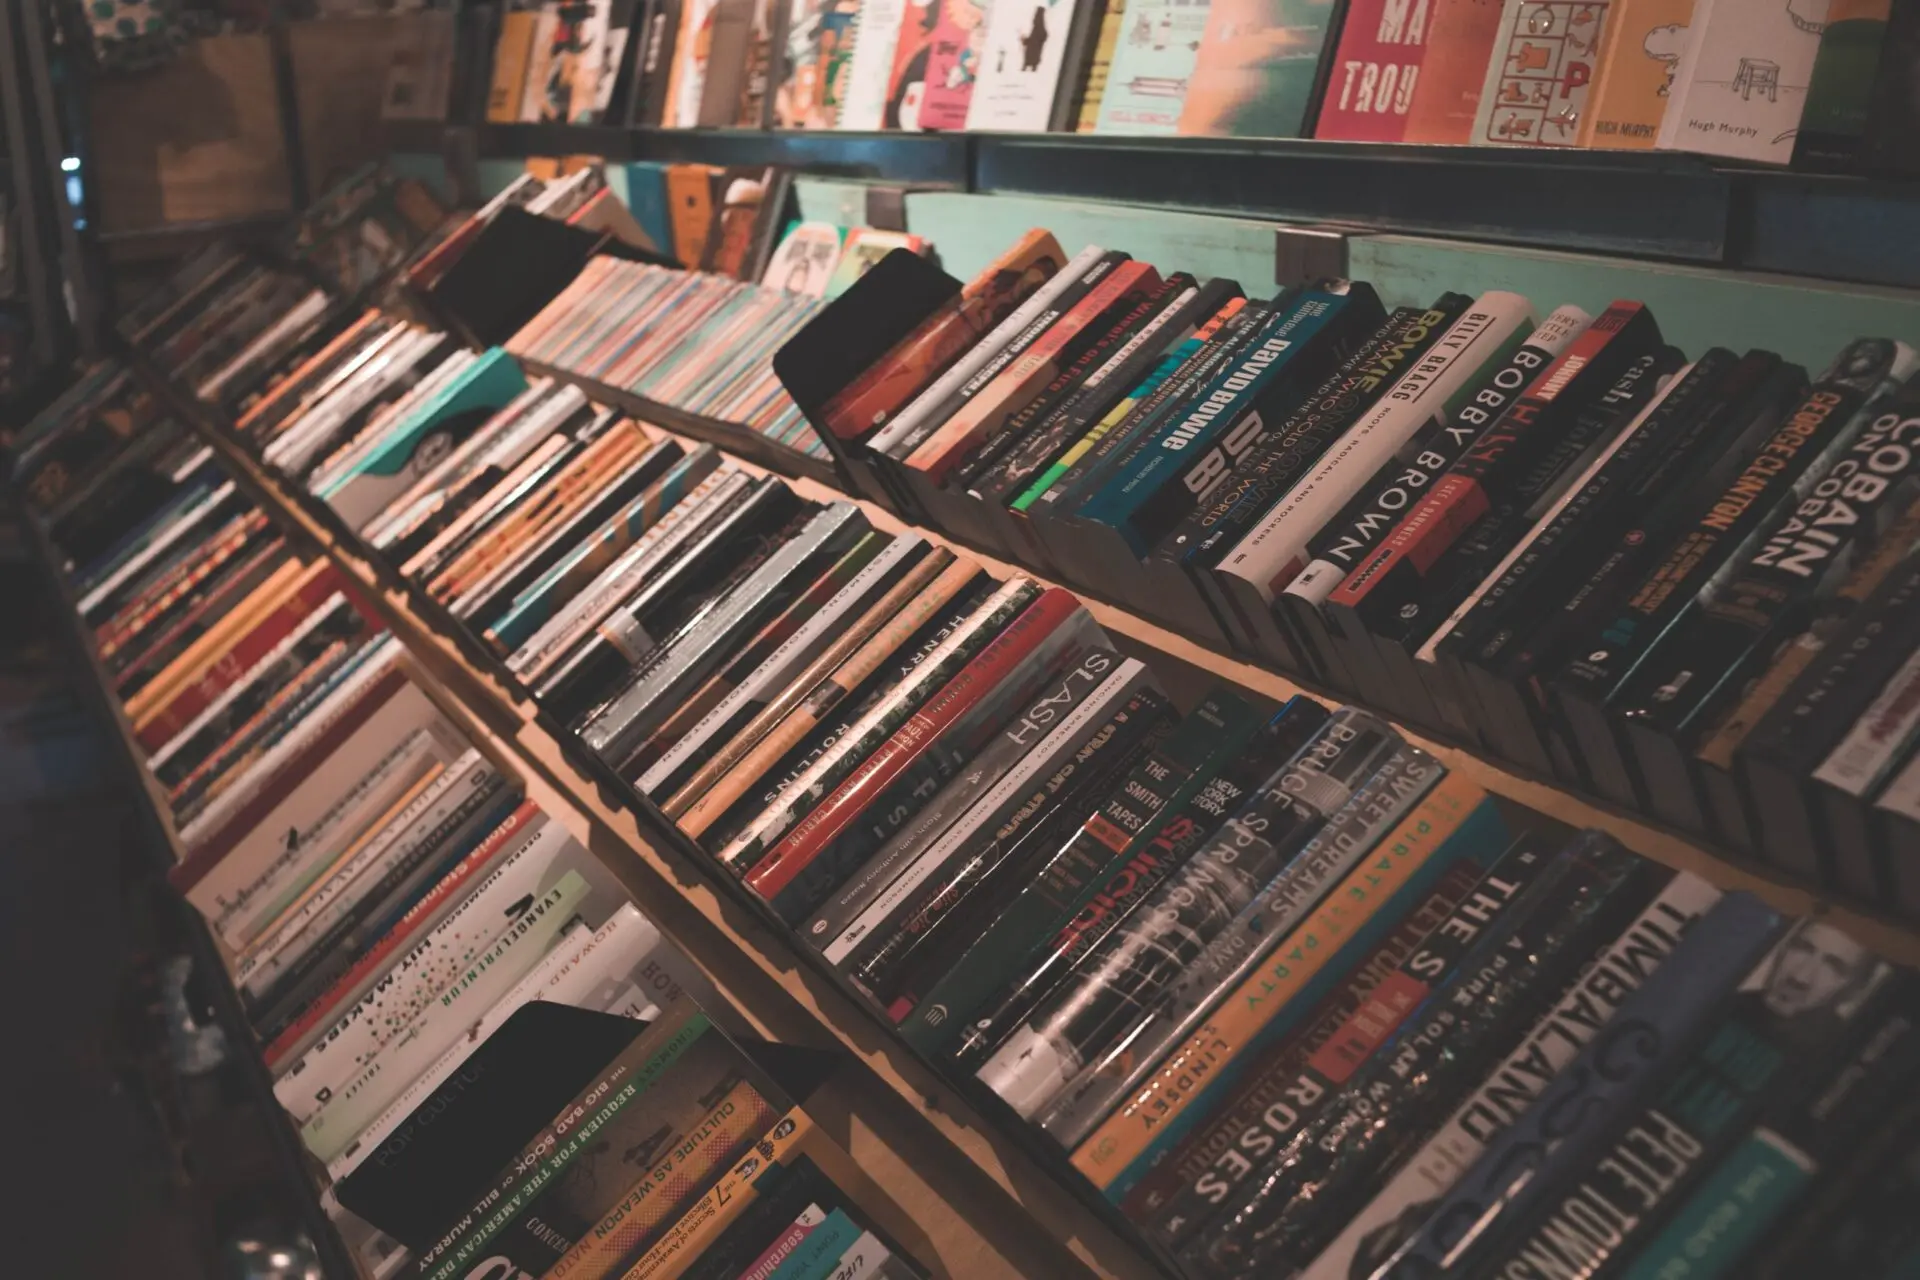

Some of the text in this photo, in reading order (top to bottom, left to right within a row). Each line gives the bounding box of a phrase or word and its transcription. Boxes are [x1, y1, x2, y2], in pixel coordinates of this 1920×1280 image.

[1619, 121, 1656, 138] MURPHY
[1688, 117, 1759, 137] Hugh Murphy
[1351, 309, 1446, 393] BOWIE
[1374, 310, 1406, 340] DAVID
[1437, 310, 1488, 359] BILLY
[1049, 363, 1083, 396] Fire
[1341, 339, 1375, 373] BOWIE
[1358, 337, 1394, 374] MAN
[1389, 355, 1443, 403] BRAGG
[1535, 353, 1585, 401] JOHNNY
[1601, 354, 1657, 407] cash
[1297, 395, 1318, 416] THE
[1316, 371, 1341, 396] AND
[1319, 375, 1360, 413] WHO
[1444, 349, 1542, 446] BOBBY
[1281, 411, 1321, 451] SOLD
[1254, 447, 1283, 476] THE
[1314, 438, 1358, 482] RADICALS
[1700, 389, 1842, 532] GEORGE CLINTON
[1199, 476, 1255, 528] WORLD
[1293, 483, 1314, 504] AND
[1328, 448, 1446, 562] BROWN
[1750, 411, 1899, 568] ON COBAIN
[820, 541, 899, 616] TESTIMONY
[749, 625, 808, 680] ROBBIE
[899, 614, 963, 678] HENRY
[660, 680, 749, 763] ROBERTSON
[1004, 648, 1109, 747] SLASH
[761, 722, 850, 804] ROLLINS
[1143, 758, 1168, 782] THE
[1262, 720, 1357, 810] BRUCE
[1105, 799, 1142, 832] TAPES
[1124, 779, 1162, 810] SMITH
[1356, 760, 1426, 834] SWEET
[401, 814, 518, 925] Gloria Steinem
[506, 831, 542, 867] DEREK
[1150, 824, 1204, 877] DREAM
[1268, 830, 1357, 919] DREAMS
[1346, 819, 1431, 903] PIRATE
[435, 869, 503, 934] THOMPSON
[1047, 812, 1194, 955] SUICIDE
[399, 939, 431, 971] HIT
[438, 888, 562, 1008] EVANGELPRENEUR
[548, 920, 616, 986] HOWARD
[1063, 911, 1117, 962] DREAM
[1205, 934, 1244, 974] DAVE
[1243, 931, 1318, 1010] PARTY
[315, 974, 395, 1052] MAKERS
[1454, 904, 1699, 1145] TIMBALAND
[1190, 874, 1521, 1206] THE ROSES
[584, 1080, 610, 1107] BIG
[1139, 1037, 1231, 1130] LINDSEY
[554, 1105, 585, 1136] BAD
[575, 1084, 636, 1144] REQUIEM
[671, 1101, 735, 1164] CULTURE
[513, 1134, 555, 1175] BOOK
[550, 1140, 578, 1169] FOR
[651, 1158, 675, 1184] AS
[1596, 1108, 1702, 1208] PETE
[471, 1187, 500, 1217] BILL
[521, 1166, 551, 1197] THE
[453, 1194, 523, 1263] AMERICAN
[592, 1180, 655, 1240] WEAPON
[637, 1195, 712, 1269] Effective Four-Hour
[678, 1184, 731, 1245] 7 Secrets of
[415, 1214, 473, 1271] MURRAY
[552, 1239, 592, 1278] NATO
